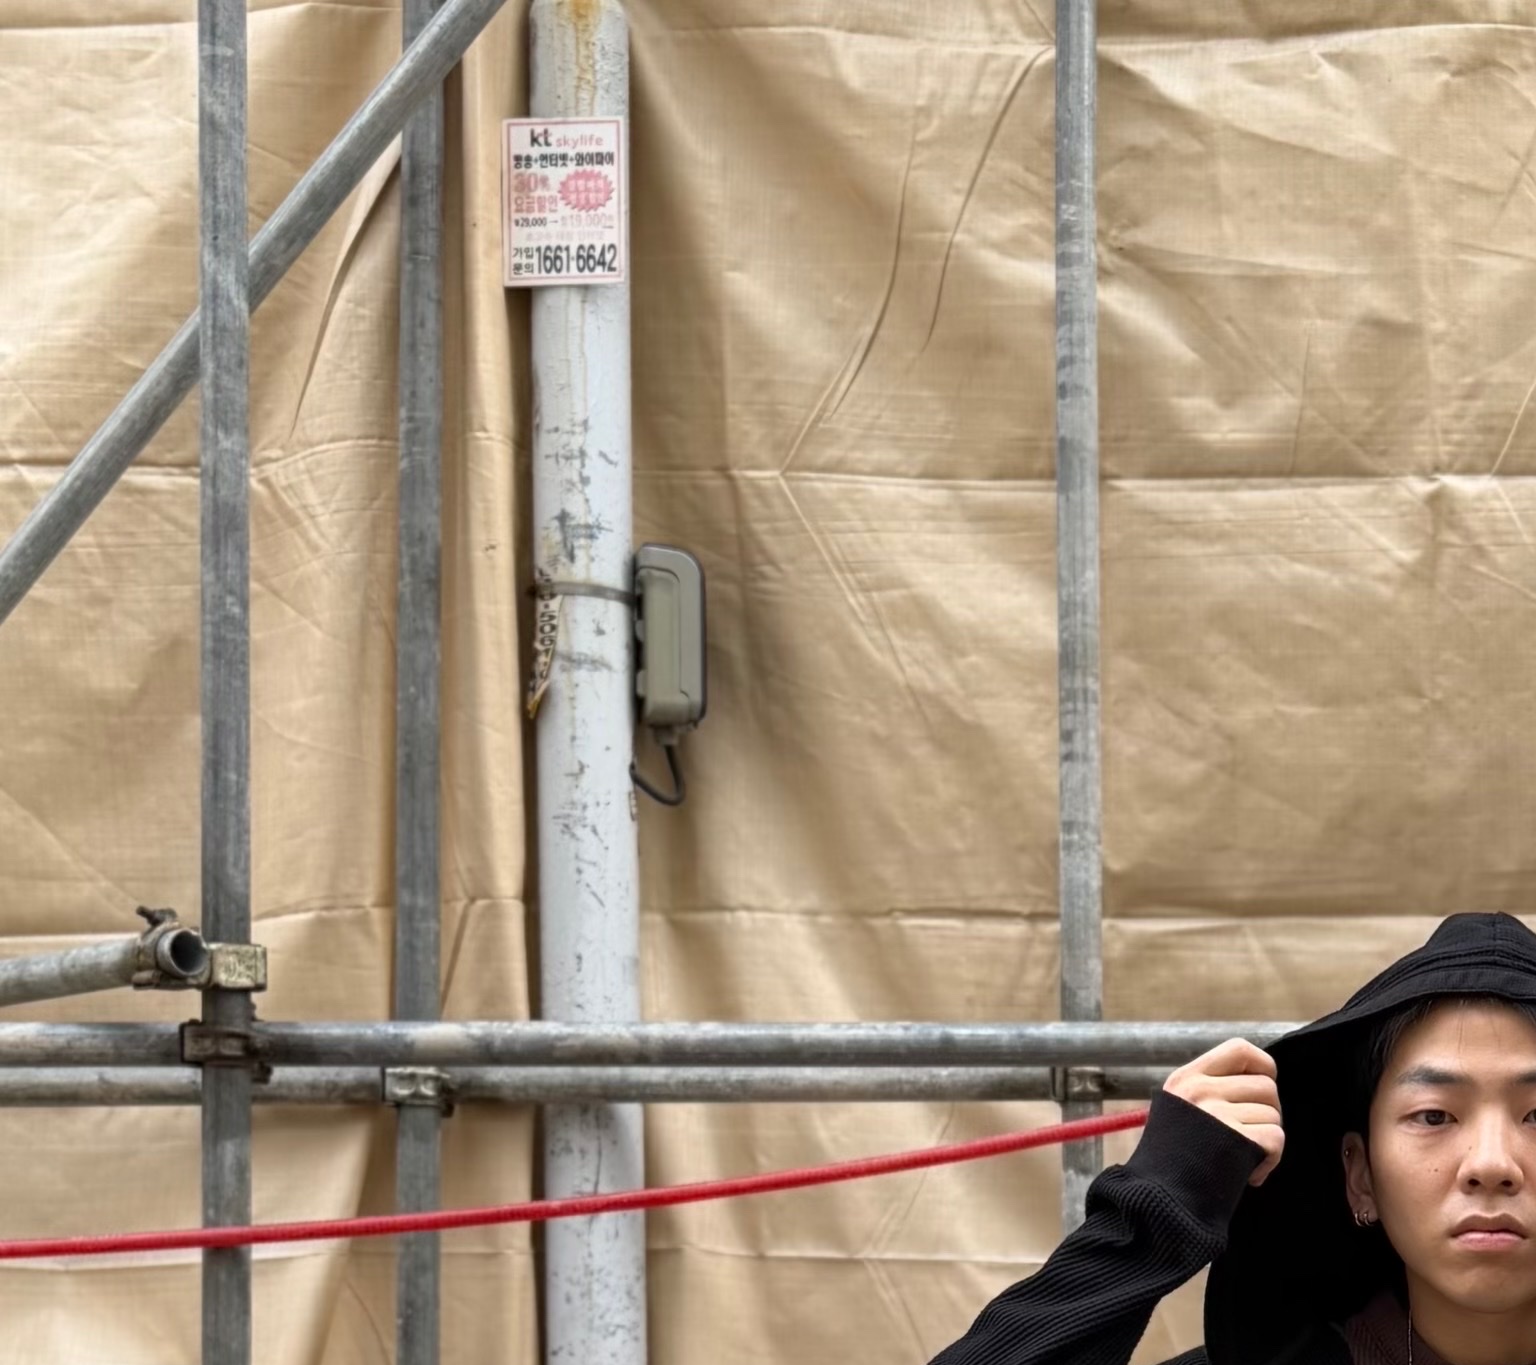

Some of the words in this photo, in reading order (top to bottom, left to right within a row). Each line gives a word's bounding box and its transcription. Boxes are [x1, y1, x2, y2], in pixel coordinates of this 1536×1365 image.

[530, 128, 552, 147] kt
[556, 134, 604, 149] skylife
[514, 195, 558, 213] 요금할인
[512, 247, 534, 260] 가입
[512, 262, 535, 275] 문의
